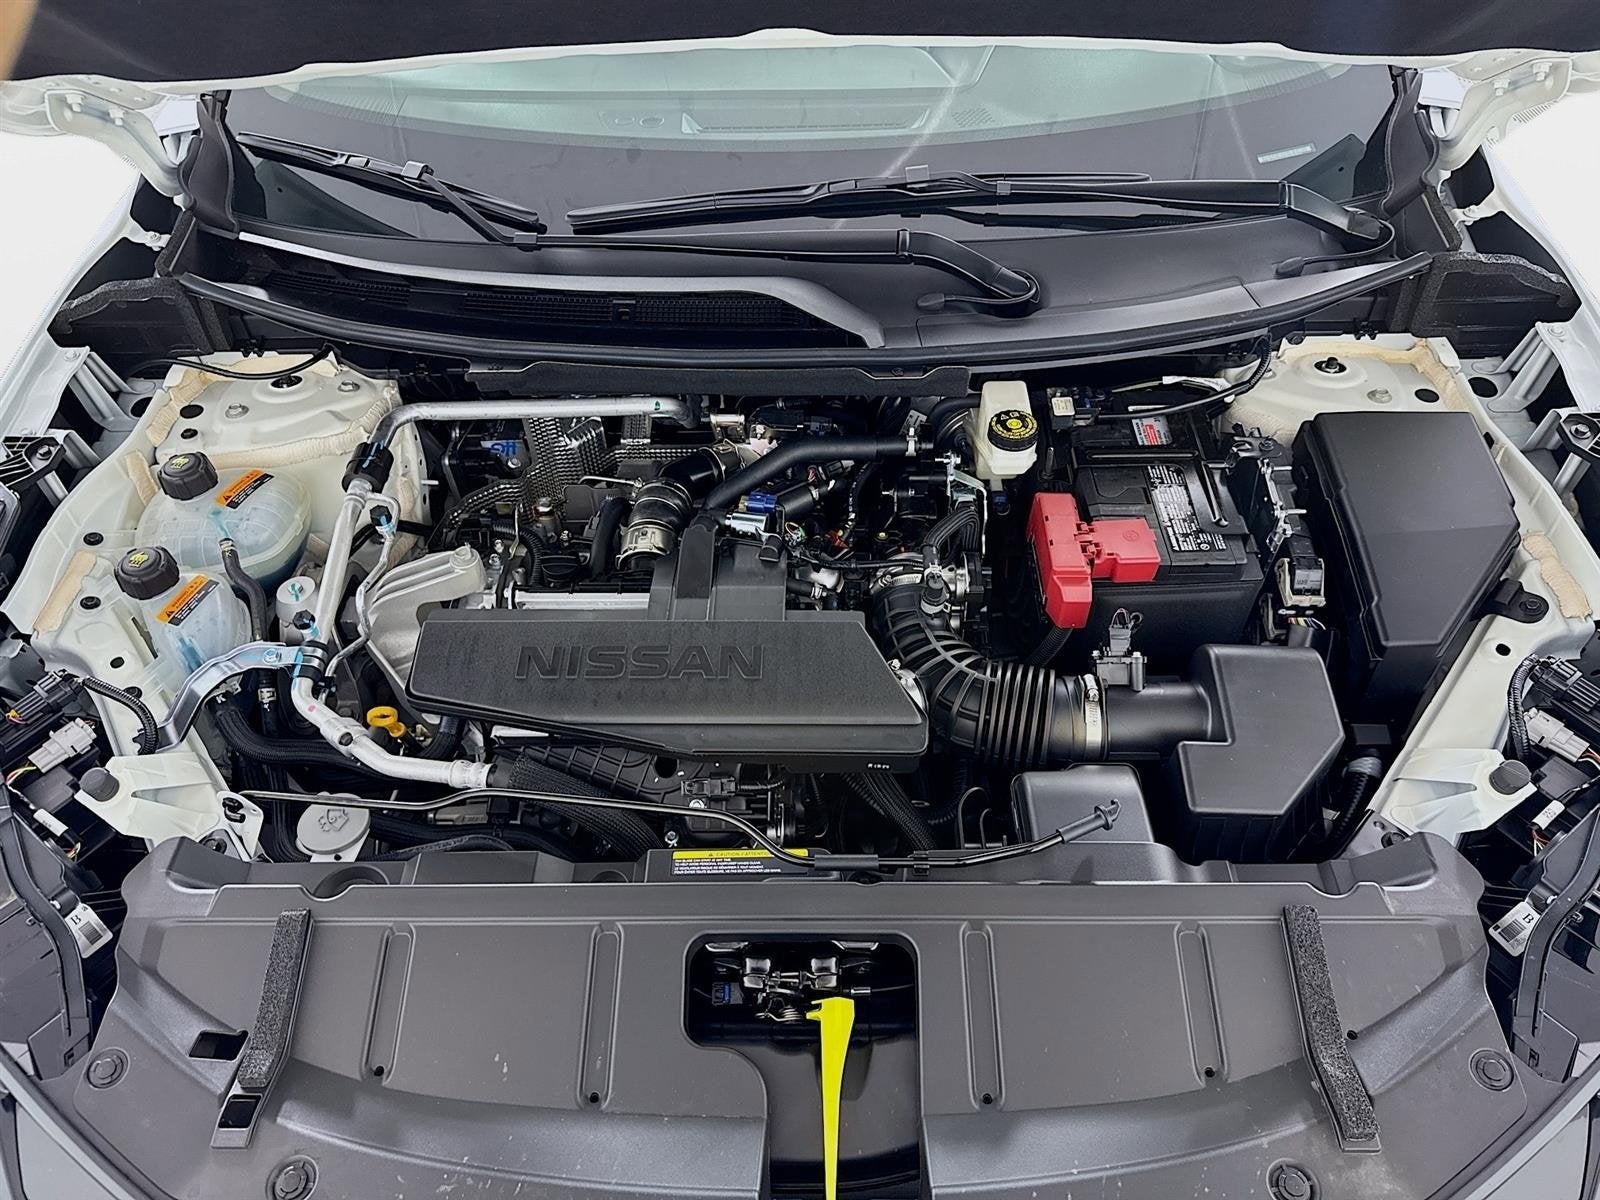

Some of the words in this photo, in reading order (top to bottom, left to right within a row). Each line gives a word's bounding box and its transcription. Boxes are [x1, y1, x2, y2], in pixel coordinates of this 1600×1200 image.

[515, 646, 764, 679] NISSAN
[71, 915, 81, 925] B
[1523, 913, 1534, 923] B
